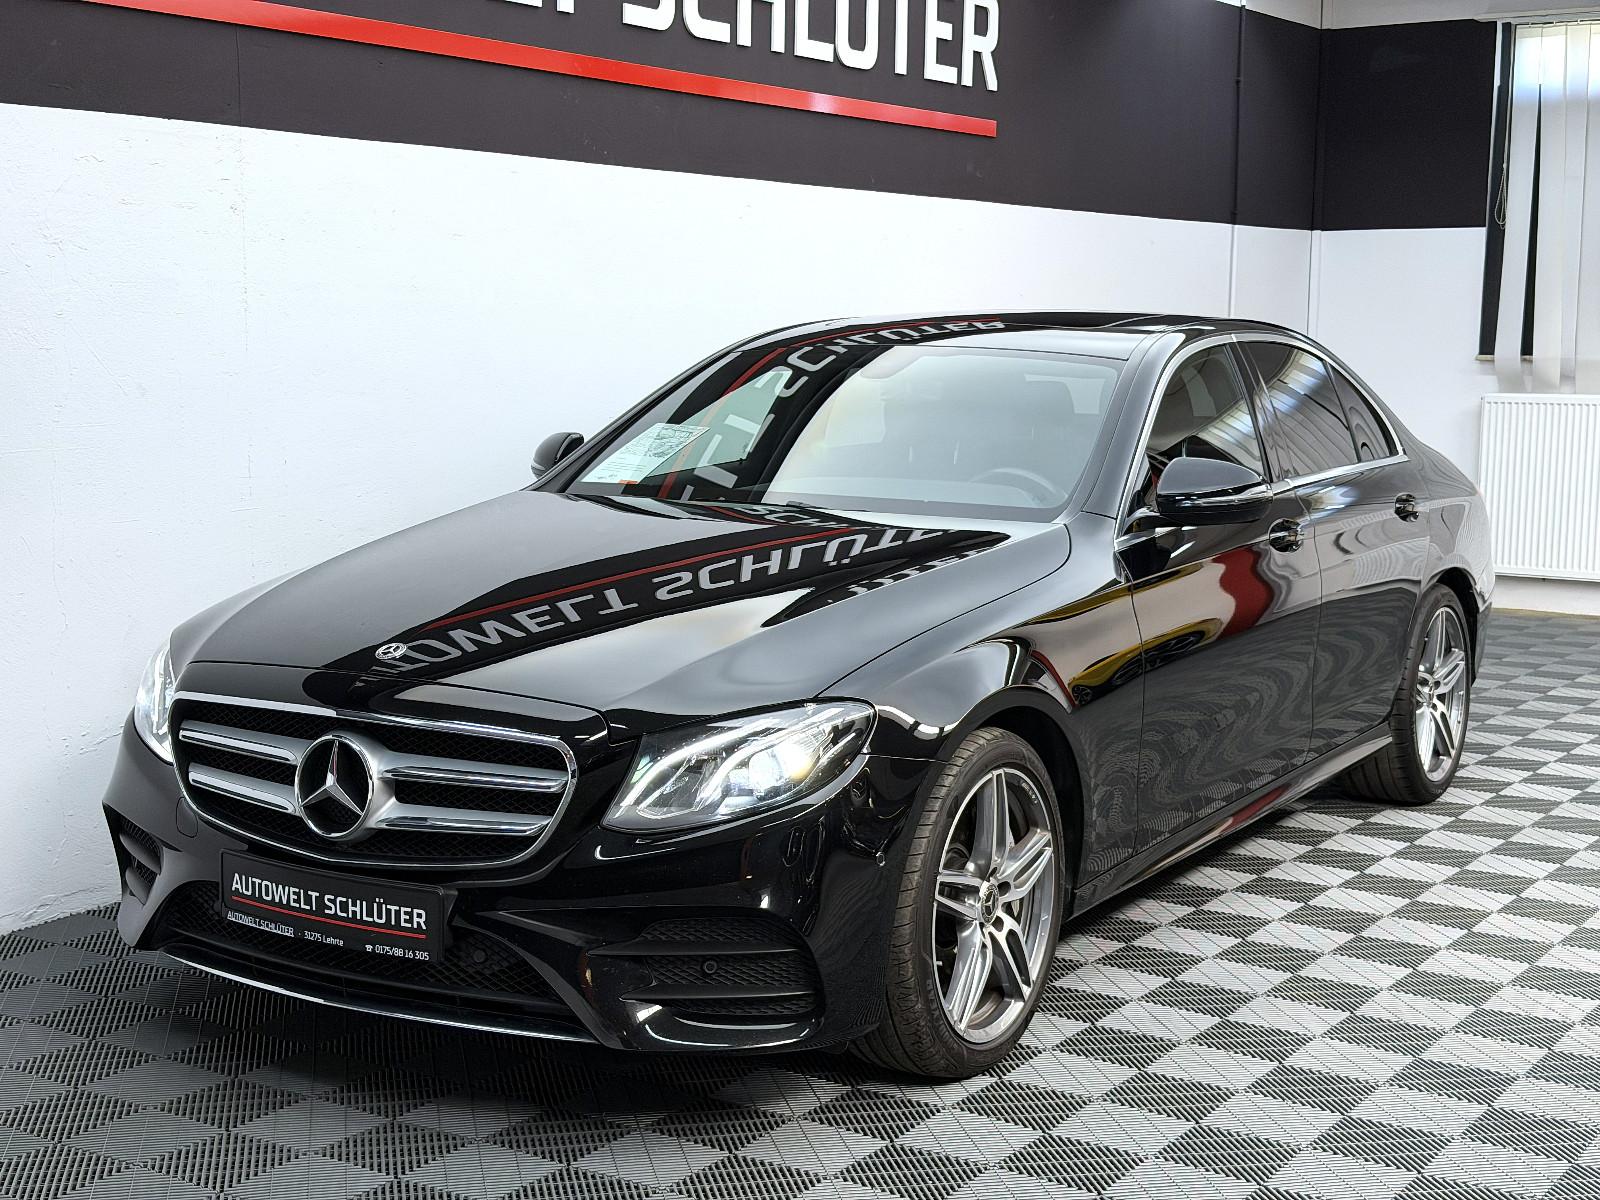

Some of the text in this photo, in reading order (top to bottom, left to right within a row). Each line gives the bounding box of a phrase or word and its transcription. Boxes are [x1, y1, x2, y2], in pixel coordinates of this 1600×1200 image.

[231, 872, 427, 930] AUTOWELT SCHLÜTER
[227, 910, 344, 947] AUTOWELT SCHLÜTER 31275 Lehrte
[375, 944, 430, 961] 0175/88 16 305
